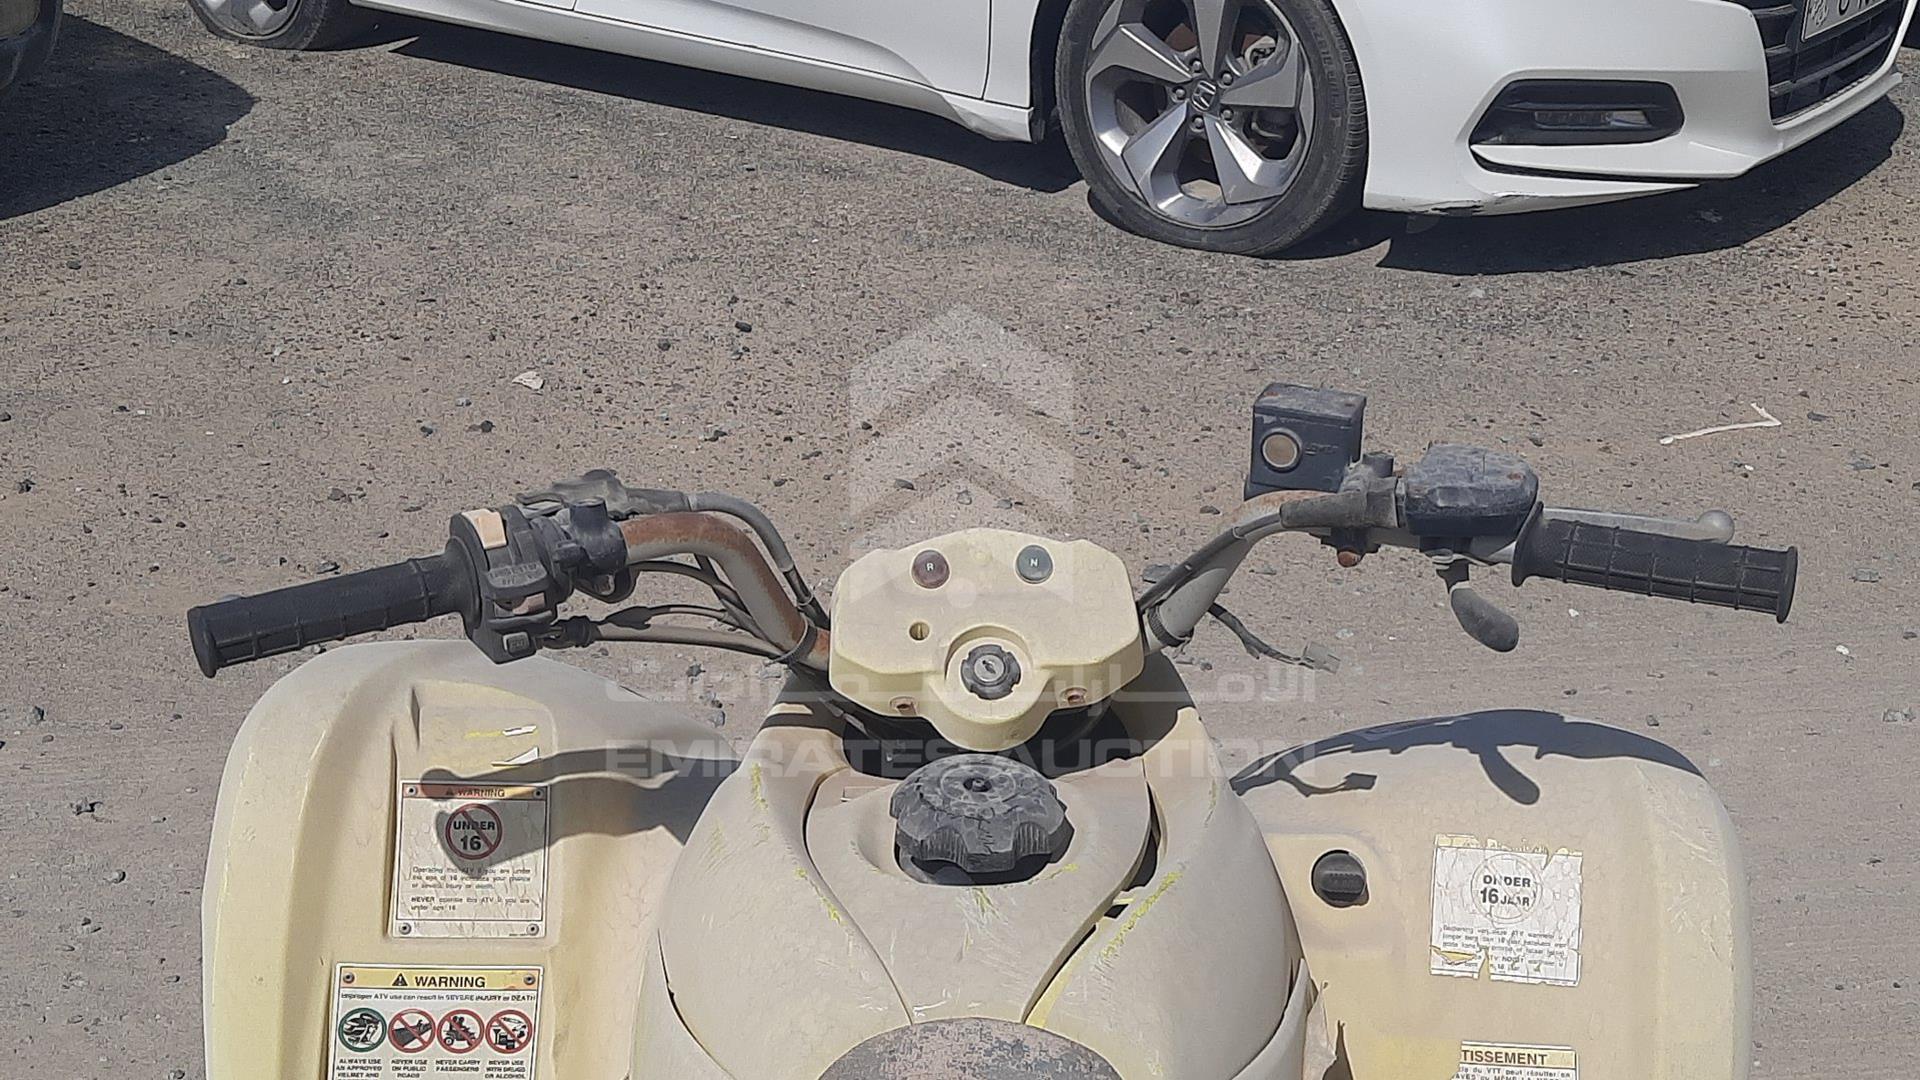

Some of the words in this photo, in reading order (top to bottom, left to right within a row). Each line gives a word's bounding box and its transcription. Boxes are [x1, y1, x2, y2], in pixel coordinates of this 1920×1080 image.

[926, 562, 935, 571] R
[1030, 558, 1039, 567] N
[457, 788, 505, 798] WARNING
[460, 835, 482, 851] 16
[1480, 887, 1498, 904] 16
[414, 975, 486, 988] WARNING
[1461, 1049, 1548, 1066] TISSEMENT
